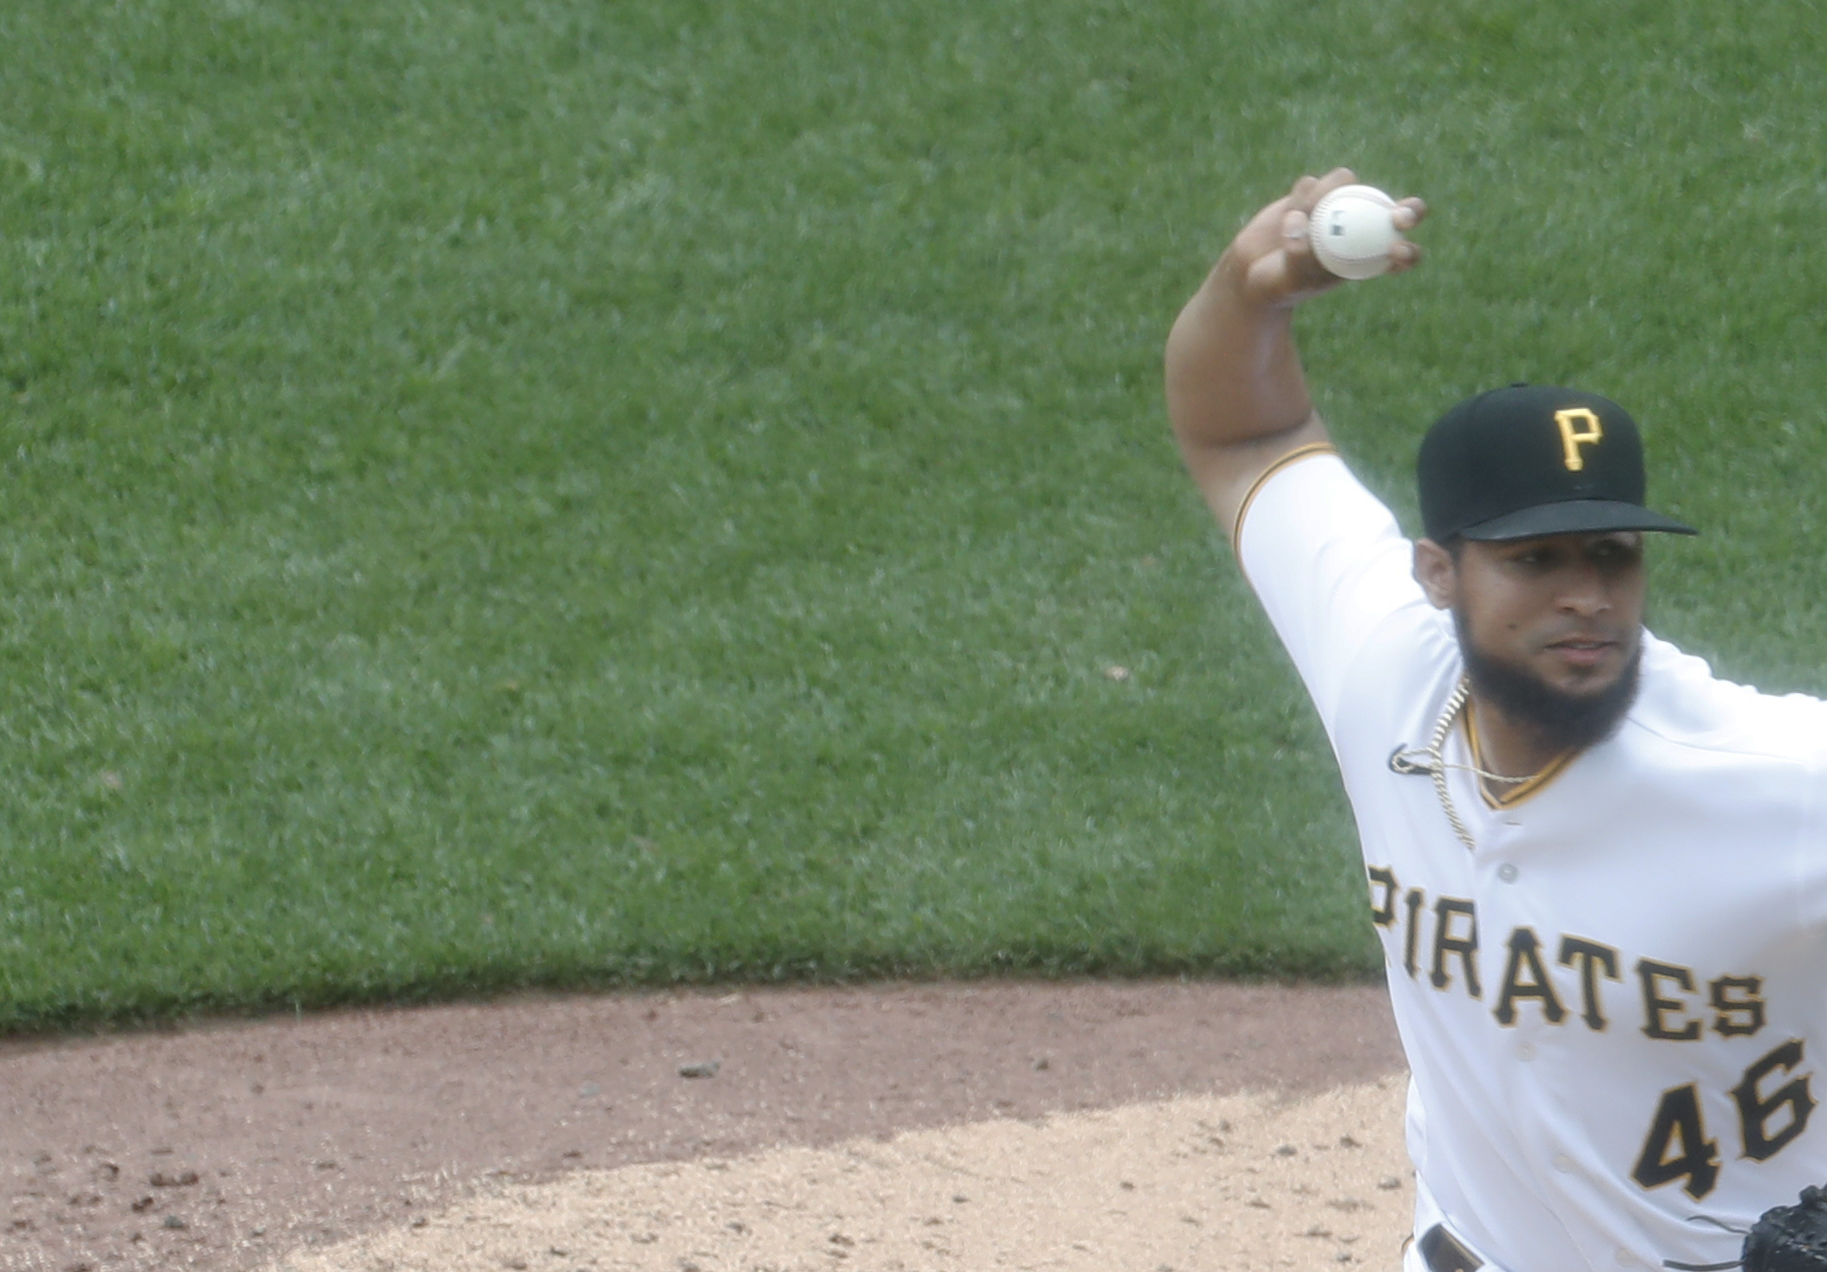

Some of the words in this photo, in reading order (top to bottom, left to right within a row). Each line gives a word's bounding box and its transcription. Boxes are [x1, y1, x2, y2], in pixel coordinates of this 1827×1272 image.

[1555, 408, 1603, 471] P
[1368, 864, 1769, 1041] PIRATES
[1632, 1038, 1819, 1202] 46
